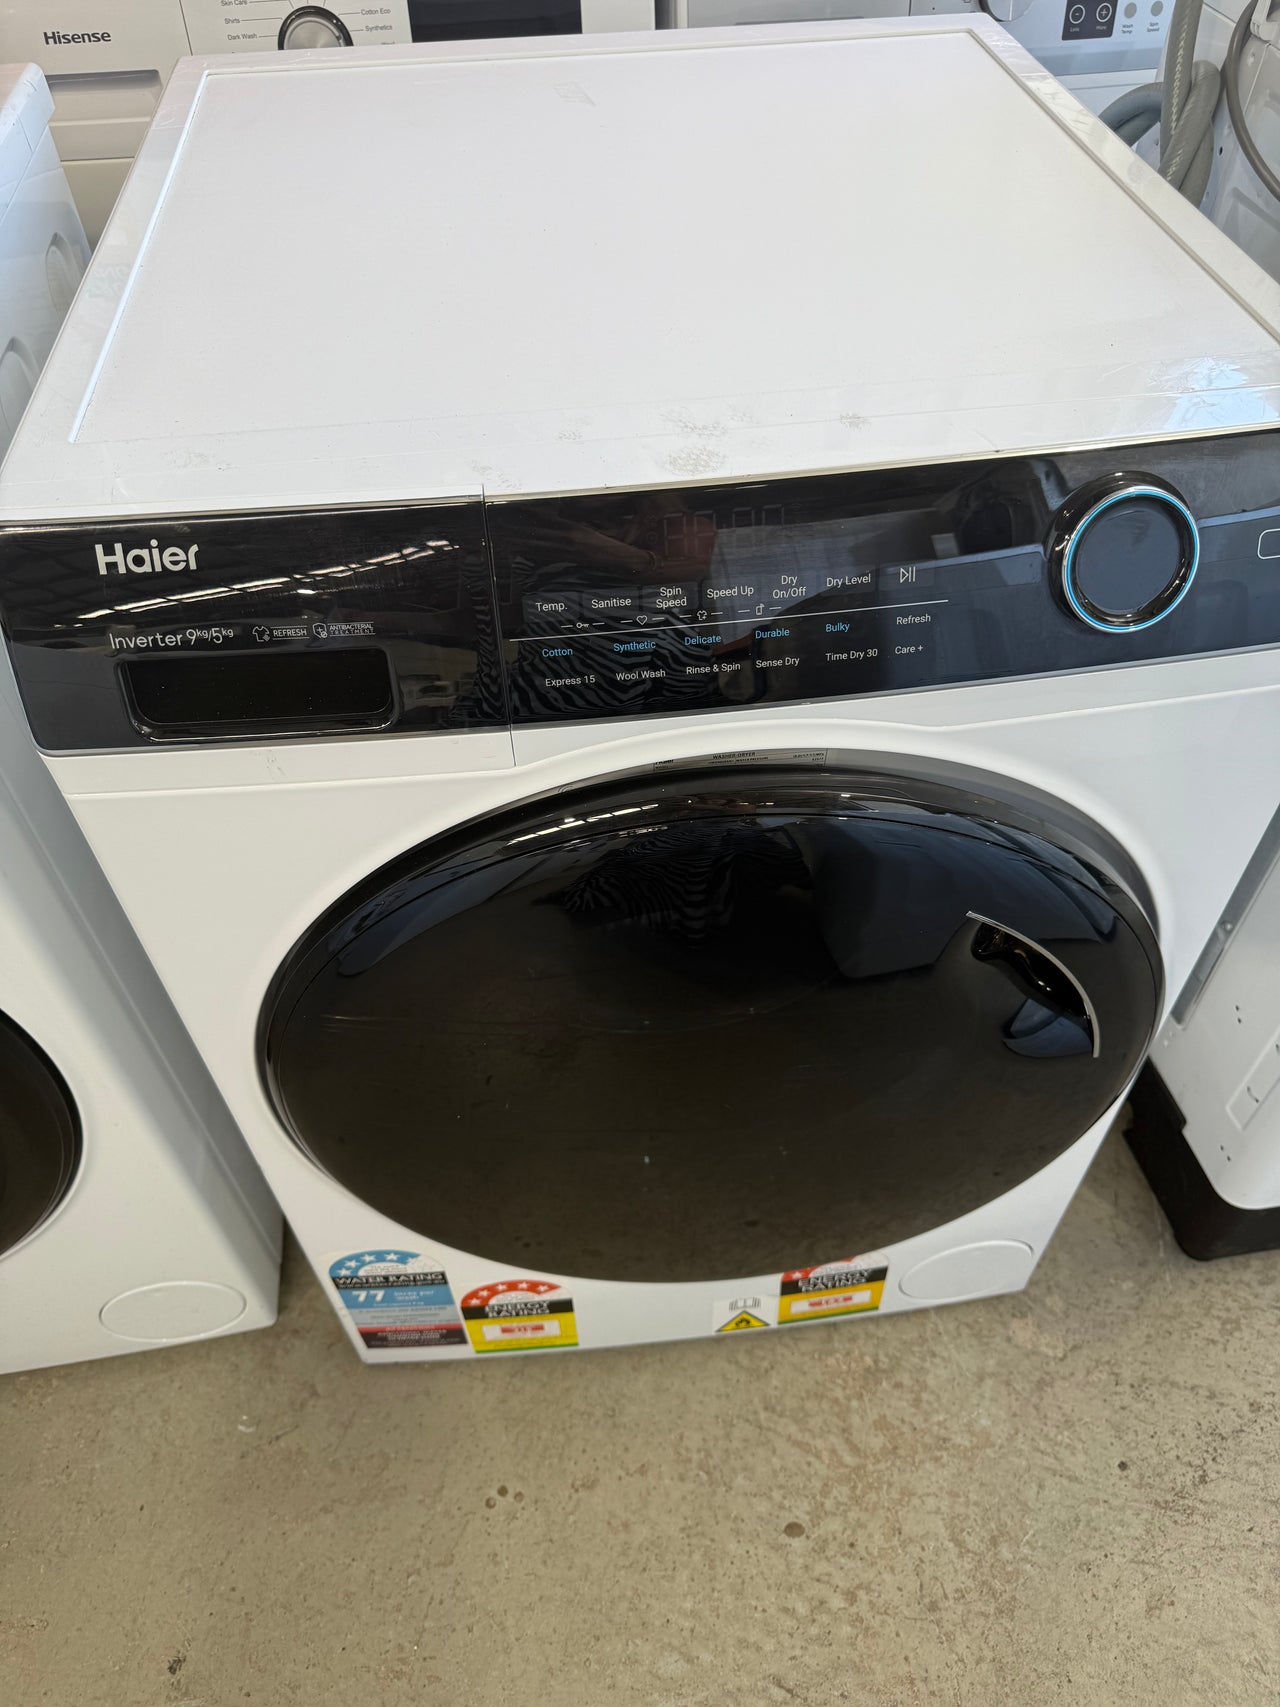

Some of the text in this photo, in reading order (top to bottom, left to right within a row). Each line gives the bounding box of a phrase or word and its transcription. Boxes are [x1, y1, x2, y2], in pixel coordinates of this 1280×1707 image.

[360, 8, 379, 16] Cotton
[43, 31, 112, 45] Hisense
[95, 538, 199, 575] Haier
[781, 575, 798, 586] Dry
[826, 573, 872, 588] Dry Level
[659, 586, 682, 597] Spin
[707, 585, 755, 600] Speed Up
[772, 586, 807, 599] On/Off
[536, 602, 568, 612] Temp.
[591, 597, 632, 609] Sanitise
[656, 597, 687, 609] Speed
[896, 613, 931, 625] Refresh
[272, 628, 308, 637] REFRESH
[329, 623, 374, 631] ANTIBACTERIAL
[755, 627, 790, 639] Durable
[825, 622, 851, 633] Bulky
[109, 627, 234, 649] Inverter 9kg/5kg
[684, 634, 722, 646] Delicate
[613, 640, 657, 652] Synthetic
[895, 645, 916, 655] Care
[541, 648, 574, 658] Cotton
[825, 648, 878, 662] Time Dry 30
[686, 662, 741, 675] Rinse & Spin
[755, 656, 801, 669] Sense Dry
[545, 674, 596, 688] Express 15
[615, 669, 666, 681] Wool Wash
[335, 1276, 388, 1285] WATER
[389, 1272, 443, 1282] RATING
[798, 1268, 872, 1288] ENERGY
[801, 1277, 867, 1294] RATING
[352, 1290, 385, 1302] 77
[485, 1300, 550, 1312] ENERGY
[487, 1307, 550, 1318] RATING
